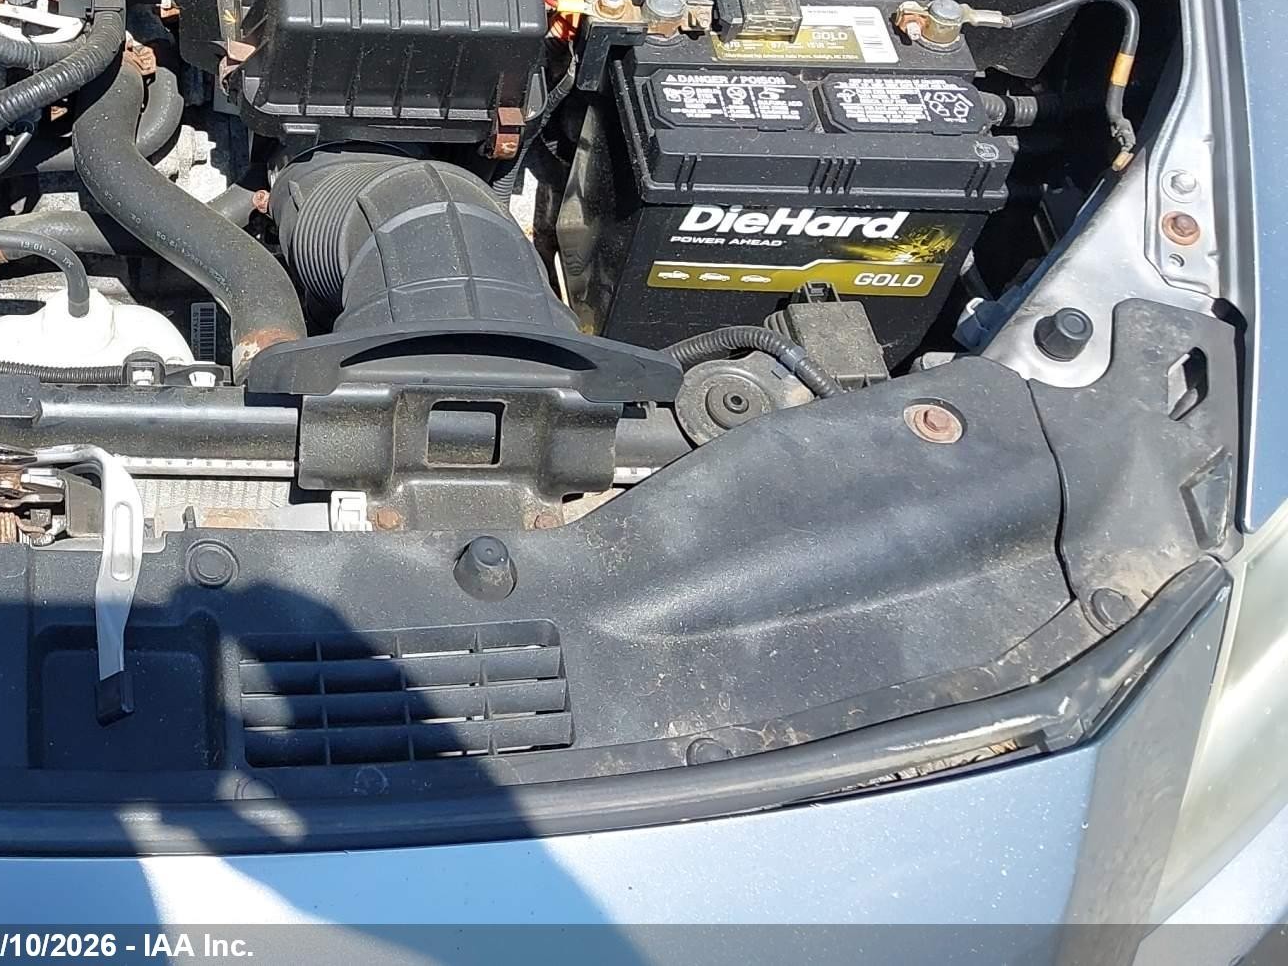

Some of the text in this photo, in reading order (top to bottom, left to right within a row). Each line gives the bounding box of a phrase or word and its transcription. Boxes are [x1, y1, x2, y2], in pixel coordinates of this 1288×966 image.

[811, 31, 849, 41] GOLD
[677, 74, 729, 84] DANGER
[741, 76, 786, 85] POISON
[677, 204, 910, 239] DieHard
[669, 235, 784, 247] POWER AHEAD
[853, 272, 925, 288] GOLD
